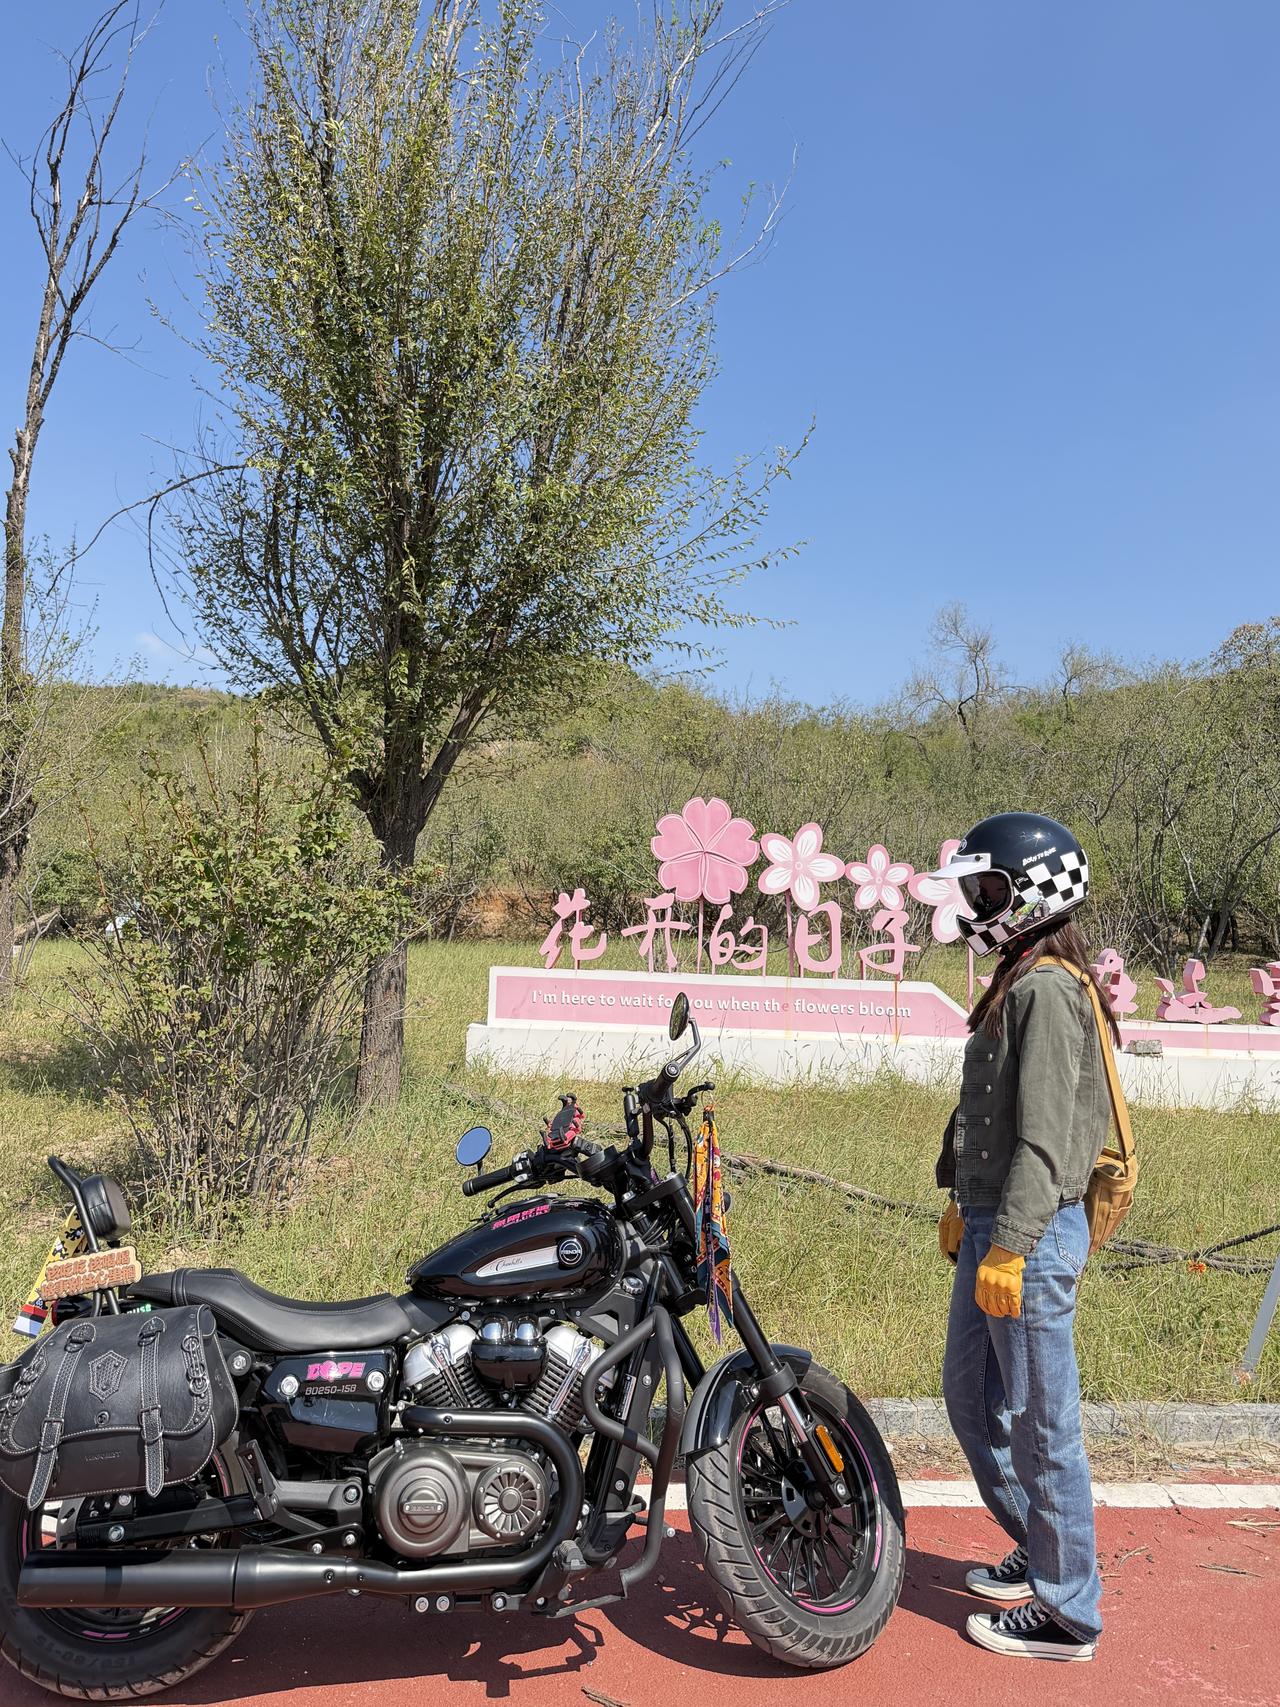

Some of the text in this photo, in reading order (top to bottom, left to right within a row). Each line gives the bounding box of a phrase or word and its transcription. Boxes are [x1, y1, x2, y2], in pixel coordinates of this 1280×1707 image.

[539, 888, 921, 974] 花开的日子
[532, 990, 557, 1004] I'm
[561, 992, 596, 1006] here
[600, 994, 616, 1006] to
[620, 995, 655, 1008] wait
[717, 997, 760, 1011] when
[764, 998, 789, 1012] the
[794, 1000, 854, 1015] flowers
[859, 1002, 911, 1018] bloom
